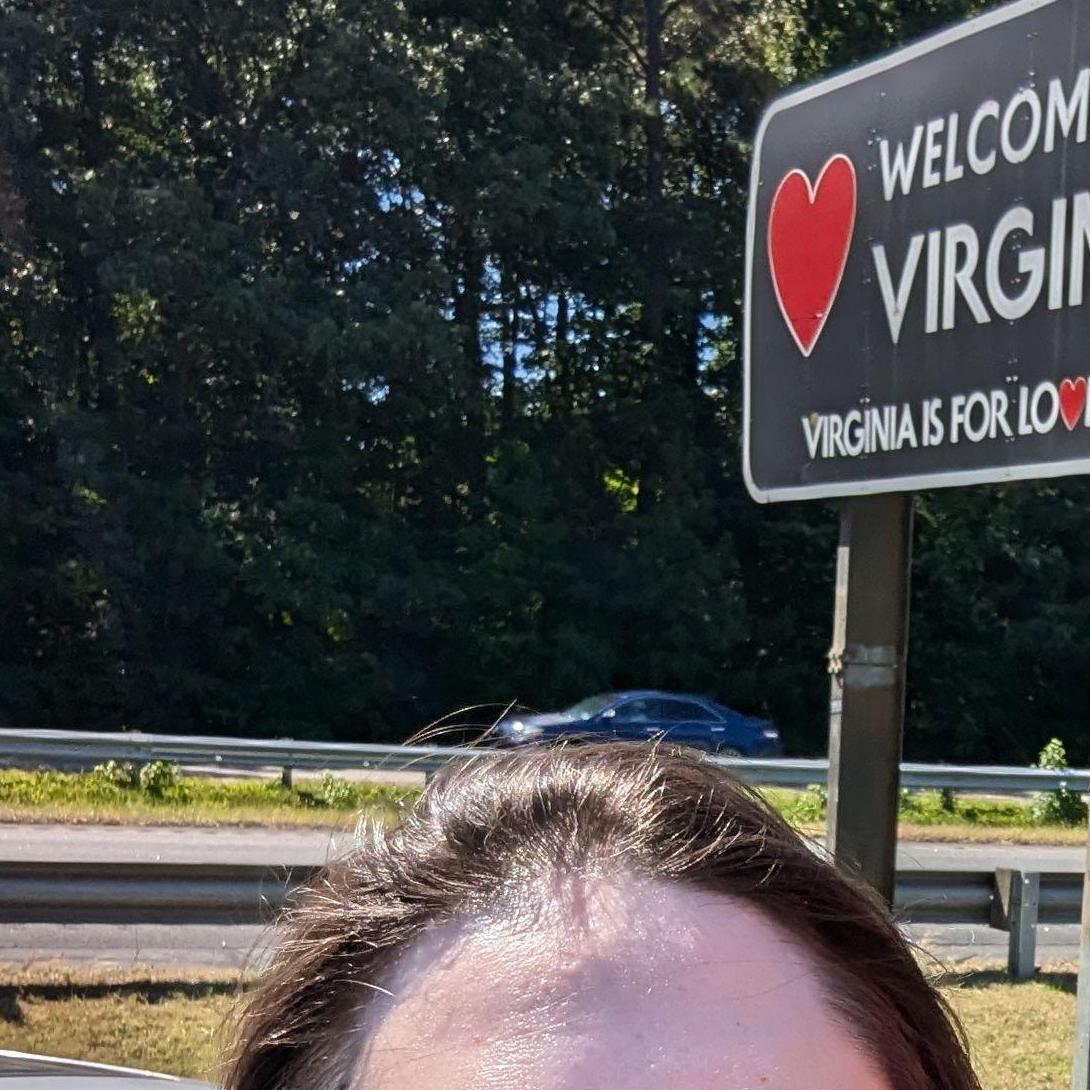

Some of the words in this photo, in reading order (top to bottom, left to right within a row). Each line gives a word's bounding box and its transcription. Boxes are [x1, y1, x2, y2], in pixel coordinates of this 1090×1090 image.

[802, 402, 918, 459] VIRGINIA
[921, 398, 944, 447] IS
[950, 389, 1014, 443] FOR
